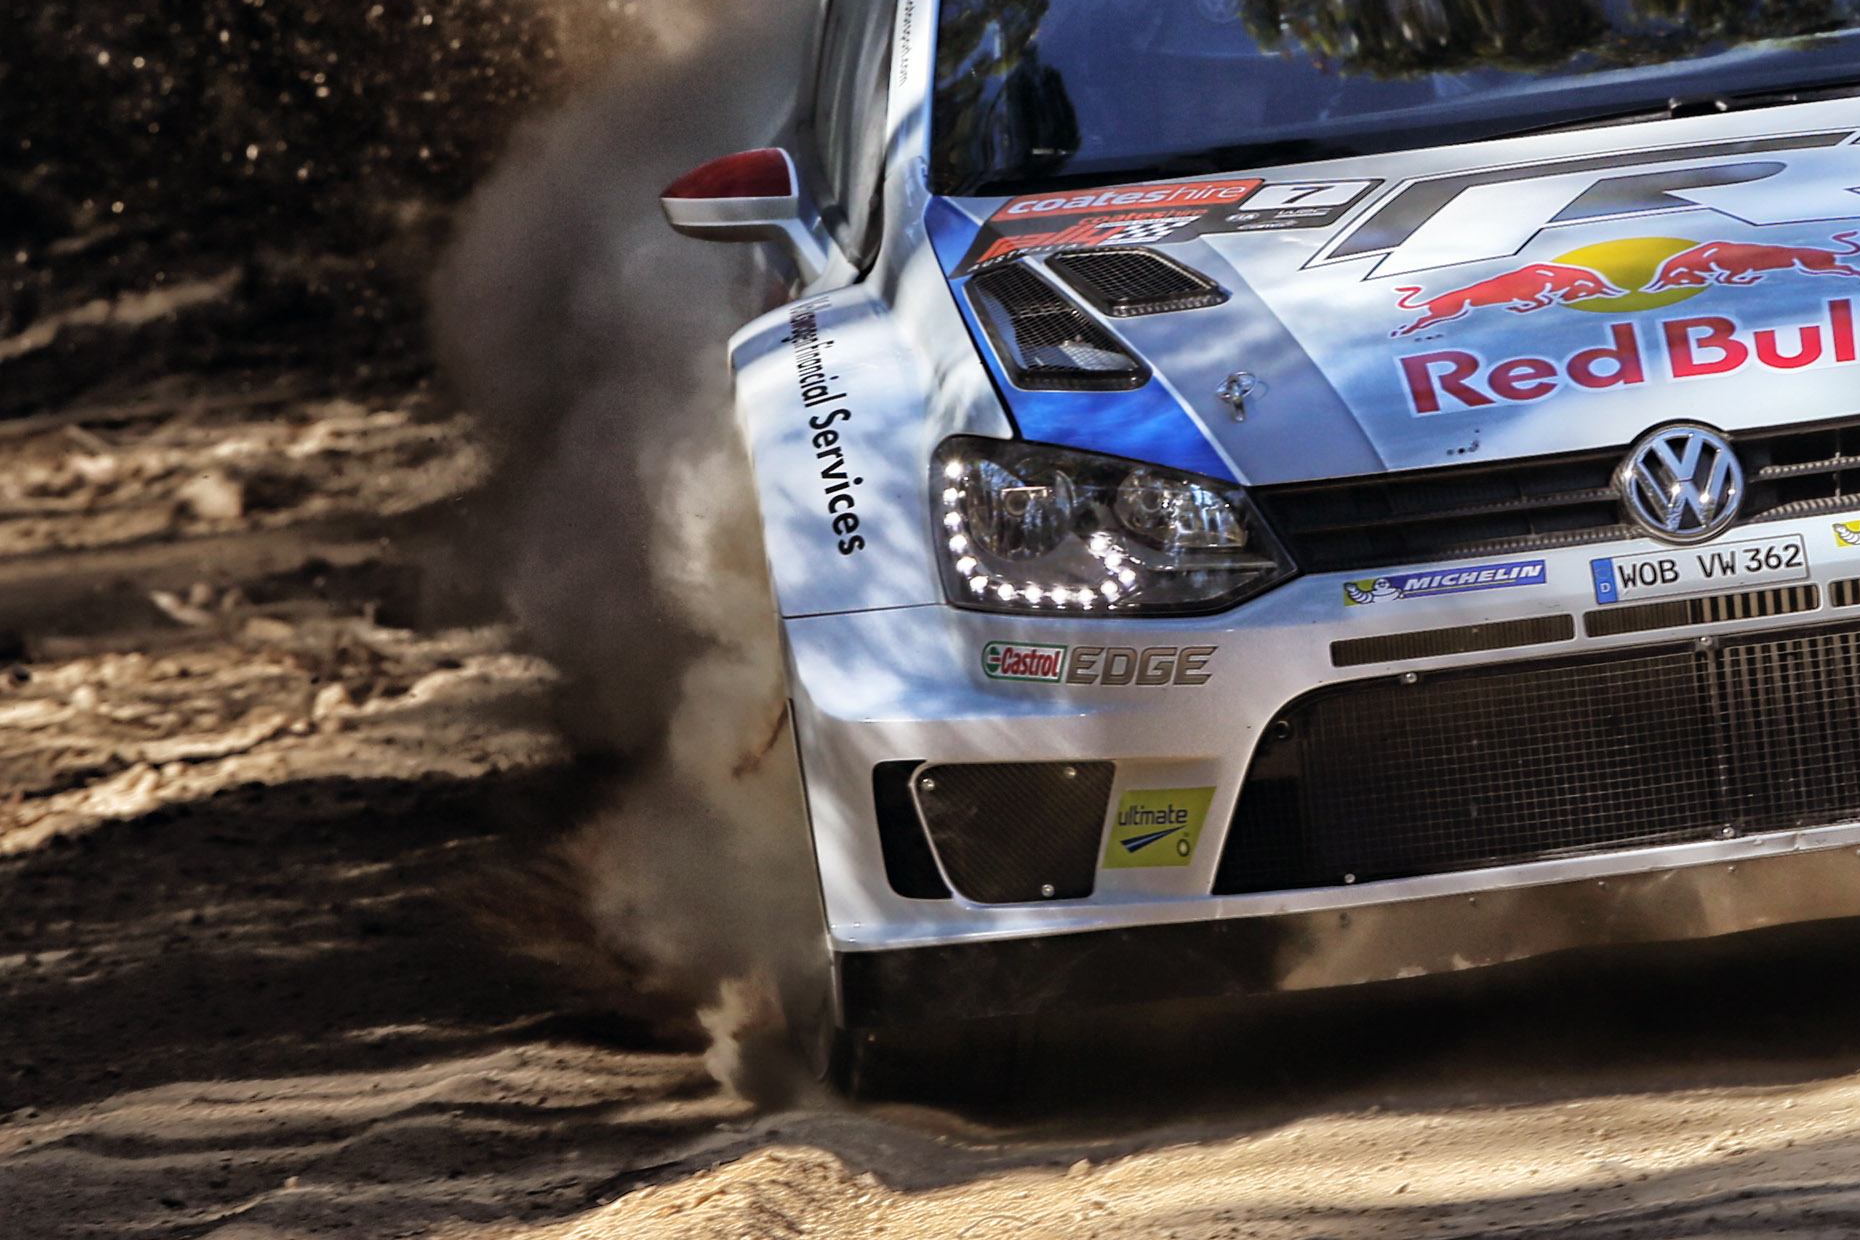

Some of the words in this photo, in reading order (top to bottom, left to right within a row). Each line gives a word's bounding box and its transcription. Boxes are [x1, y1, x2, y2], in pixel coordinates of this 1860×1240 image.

[1281, 185, 1336, 205] 7
[794, 340, 847, 408] Financial
[1399, 320, 1645, 415] Red
[808, 408, 866, 556] Services
[1403, 564, 1543, 592] MICHELIN
[1600, 582, 1612, 594] D
[1617, 558, 1681, 589] WOB
[1696, 549, 1737, 579] VW
[1743, 543, 1804, 573] 362
[1001, 646, 1060, 678] Castrol
[1065, 645, 1219, 686] EDGE
[1117, 803, 1189, 827] ultimate
